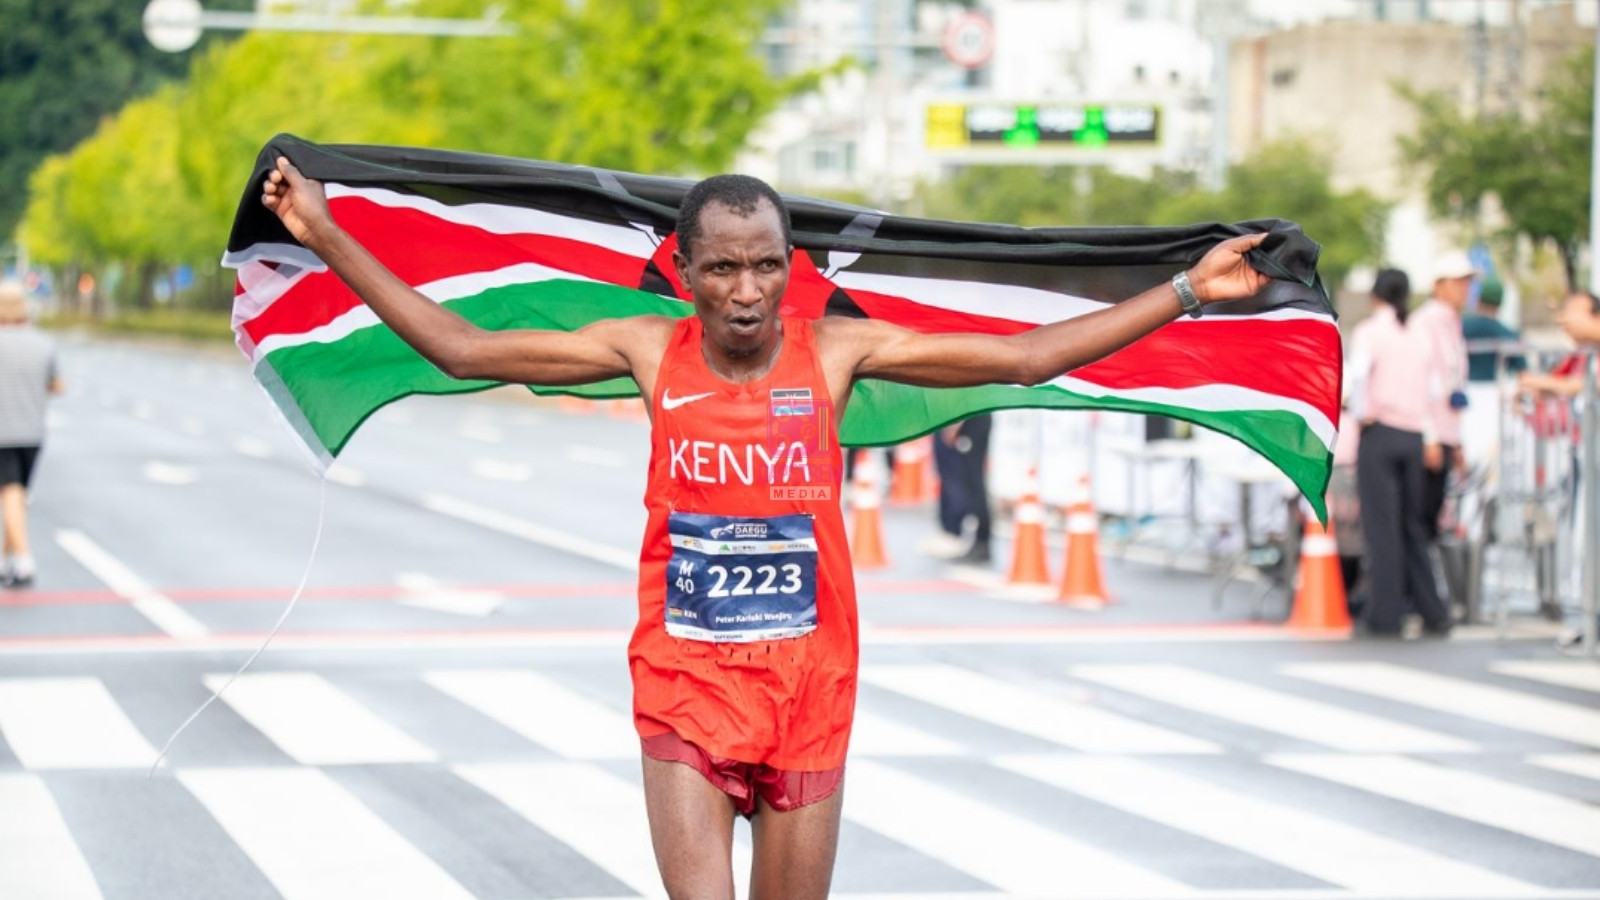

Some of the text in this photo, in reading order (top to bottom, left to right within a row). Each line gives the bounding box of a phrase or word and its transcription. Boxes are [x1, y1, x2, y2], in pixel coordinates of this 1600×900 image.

[669, 438, 811, 485] KENYA
[735, 526, 767, 535] DAEGU
[679, 560, 694, 576] M
[675, 577, 695, 594] 40
[707, 563, 802, 597] 2223
[684, 609, 698, 619] KEN
[715, 614, 735, 623] Peter
